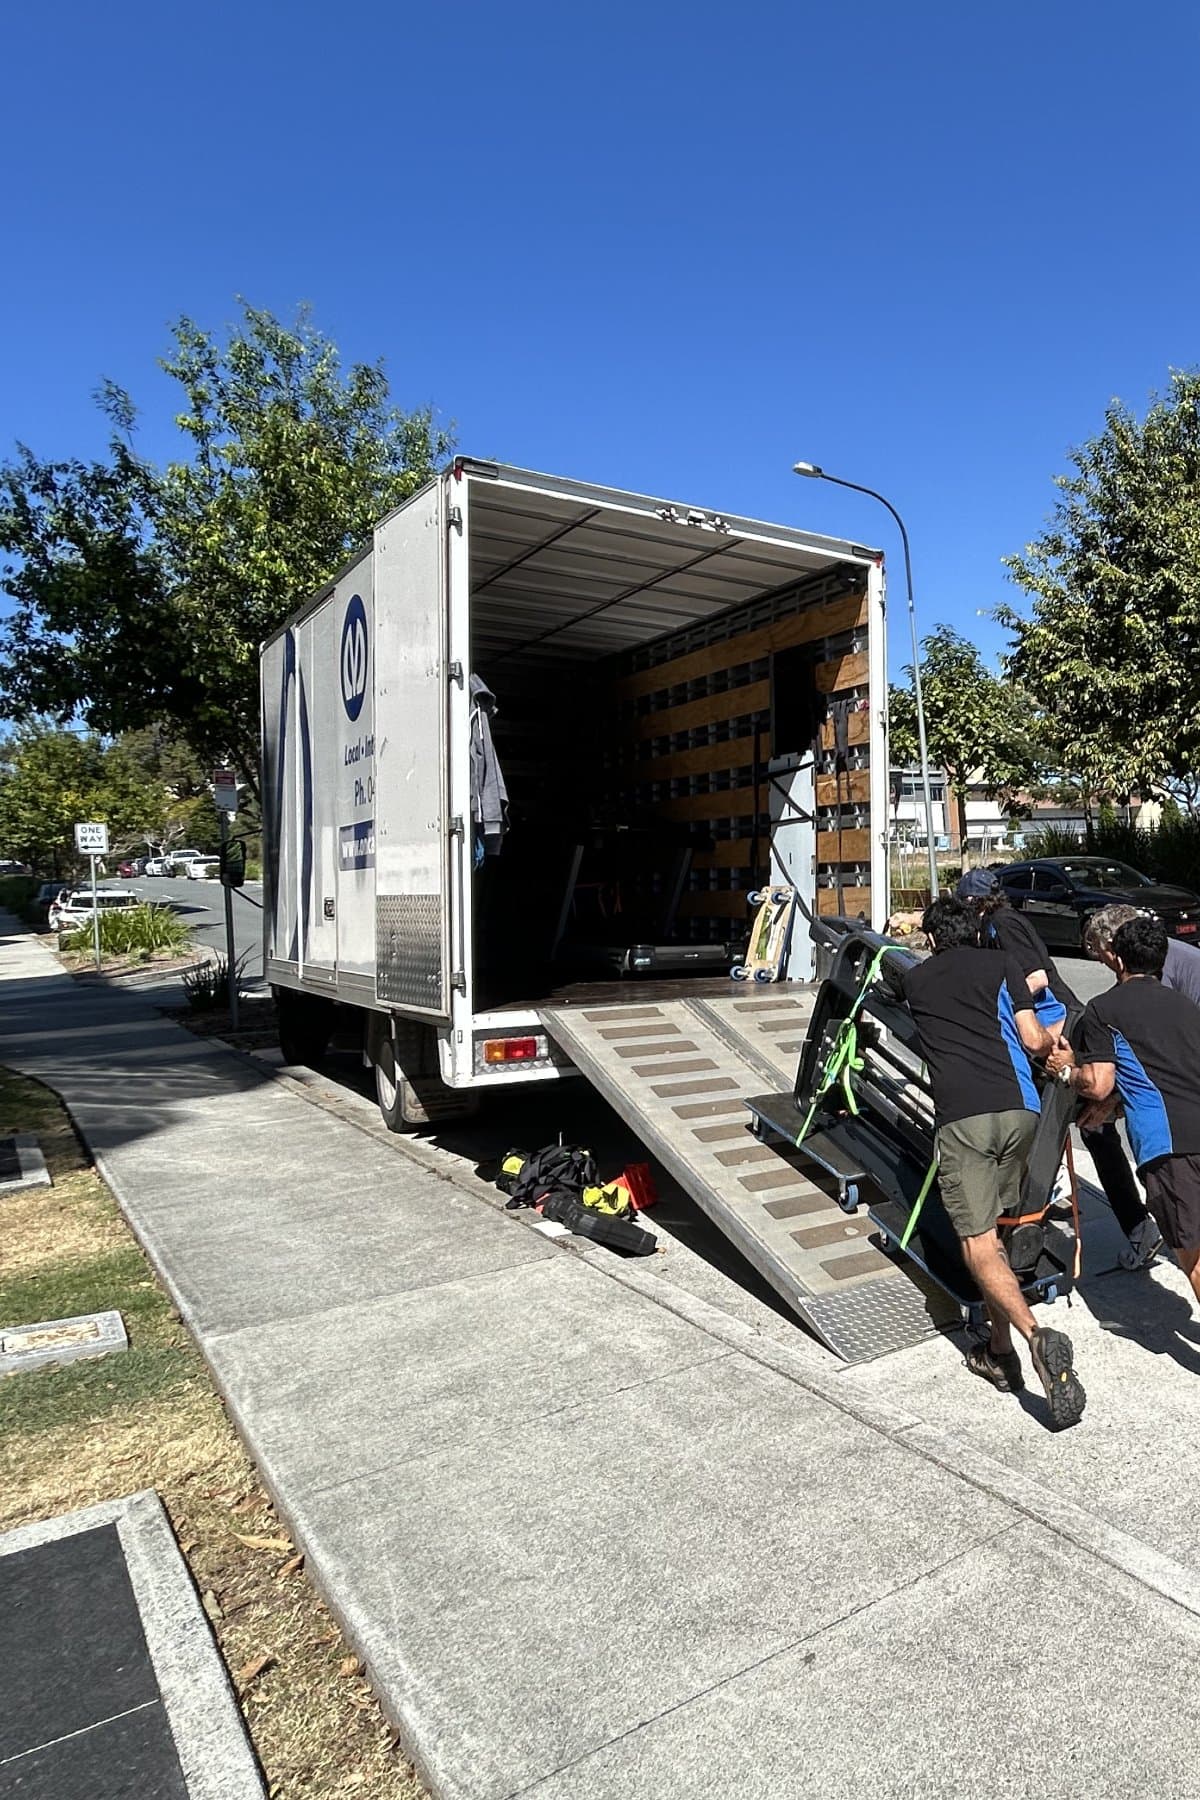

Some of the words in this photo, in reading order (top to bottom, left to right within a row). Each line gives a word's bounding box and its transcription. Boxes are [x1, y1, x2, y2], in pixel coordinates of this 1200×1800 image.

[344, 738, 360, 766] Local
[80, 826, 102, 834] ONE
[80, 835, 103, 843] WAY
